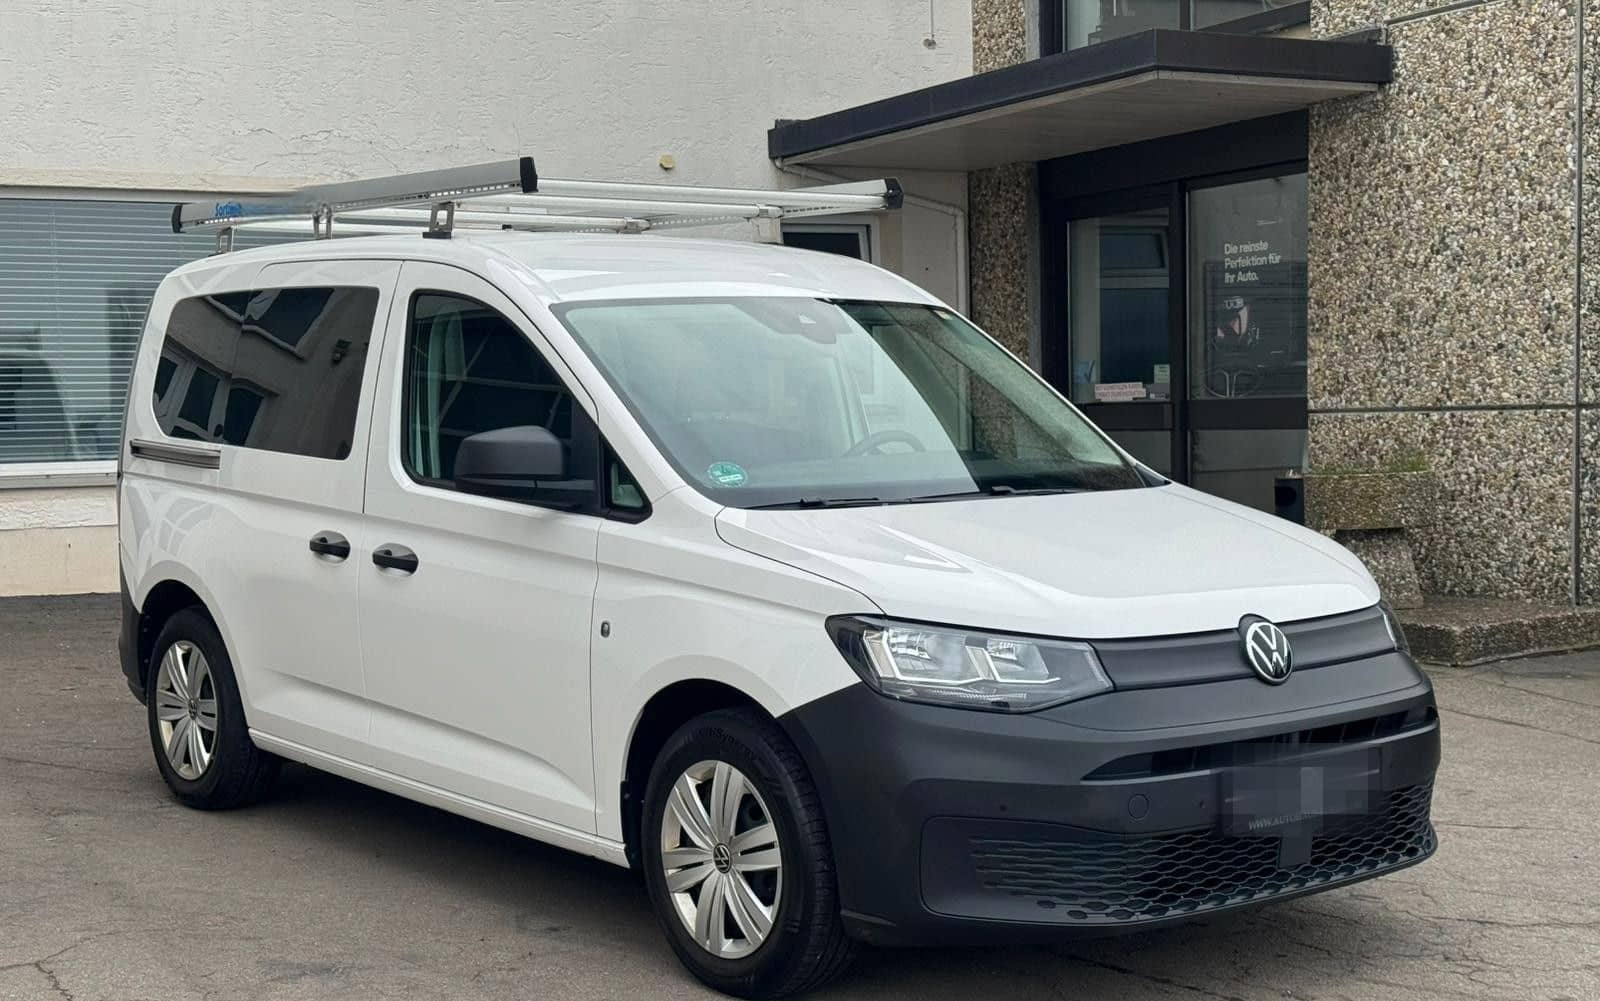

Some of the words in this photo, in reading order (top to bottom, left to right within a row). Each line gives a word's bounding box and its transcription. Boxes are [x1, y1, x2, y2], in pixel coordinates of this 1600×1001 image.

[1224, 243, 1238, 255] Die
[1239, 241, 1268, 253] reinste
[1224, 256, 1267, 269] Perfektion
[1268, 252, 1280, 264] für
[1224, 273, 1235, 283] Ihr
[1237, 270, 1259, 282] Auto.
